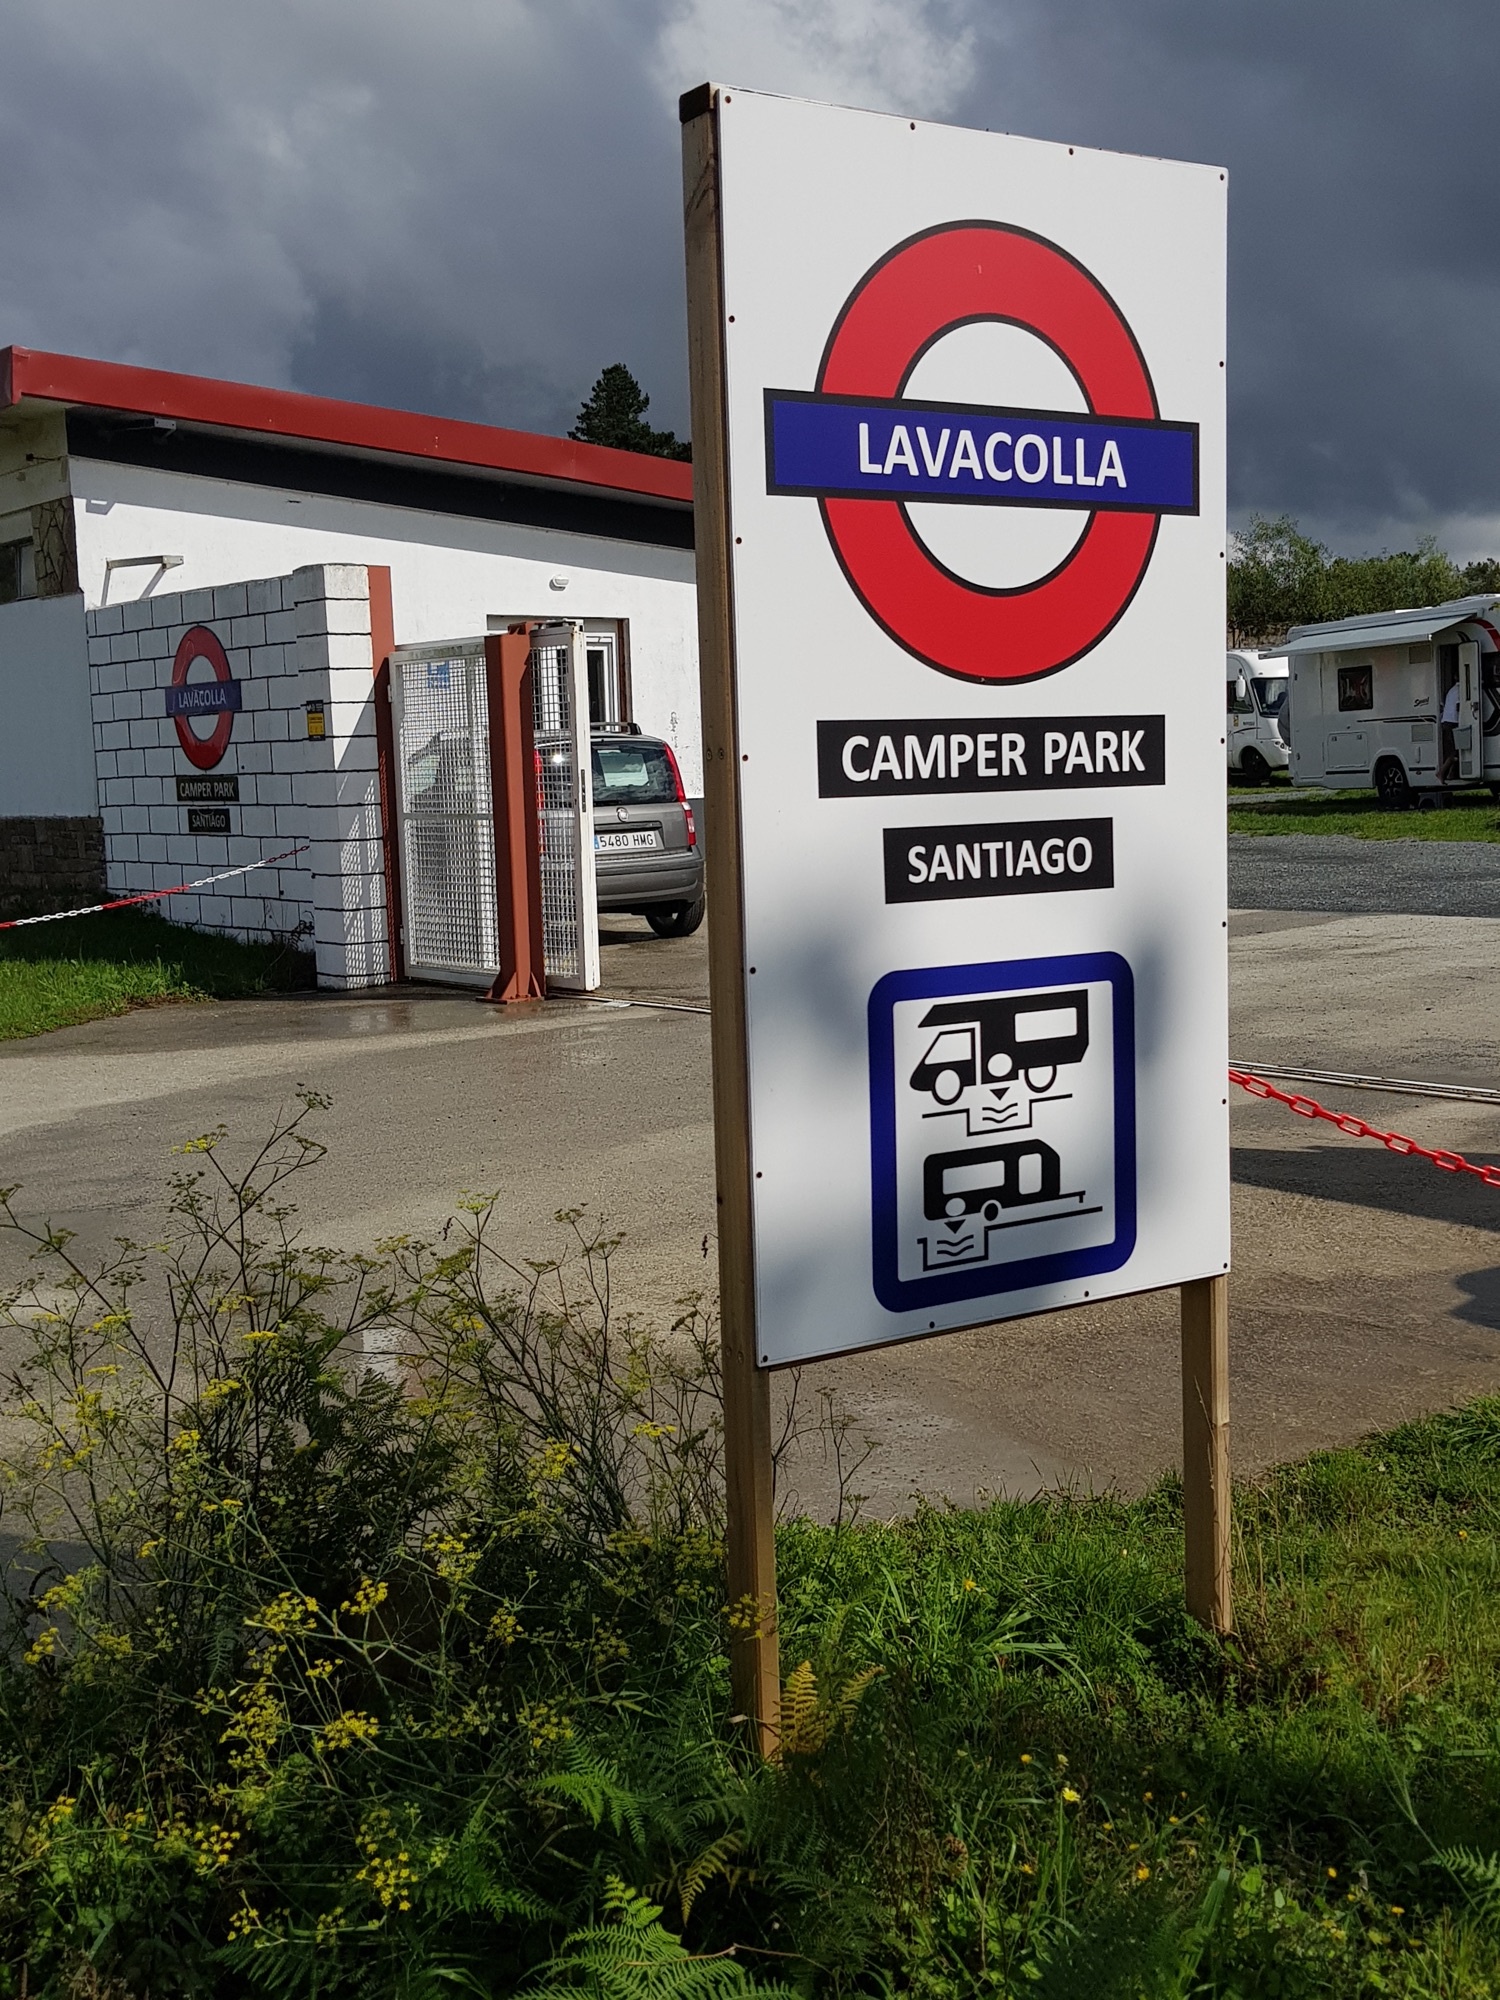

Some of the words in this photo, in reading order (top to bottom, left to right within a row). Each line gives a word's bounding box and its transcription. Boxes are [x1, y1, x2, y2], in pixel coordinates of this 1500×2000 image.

[858, 423, 1127, 488] LAVACOLLA
[178, 688, 227, 708] LAVACOLLA
[841, 732, 1027, 783] CAMPER
[1044, 729, 1146, 775] PARK
[179, 782, 212, 798] CAMPER
[213, 782, 235, 797] PARK
[192, 814, 226, 828] SANTIAGO
[600, 834, 629, 847] 5480
[633, 833, 654, 846] HMG
[907, 836, 1093, 884] SANTIAGO
